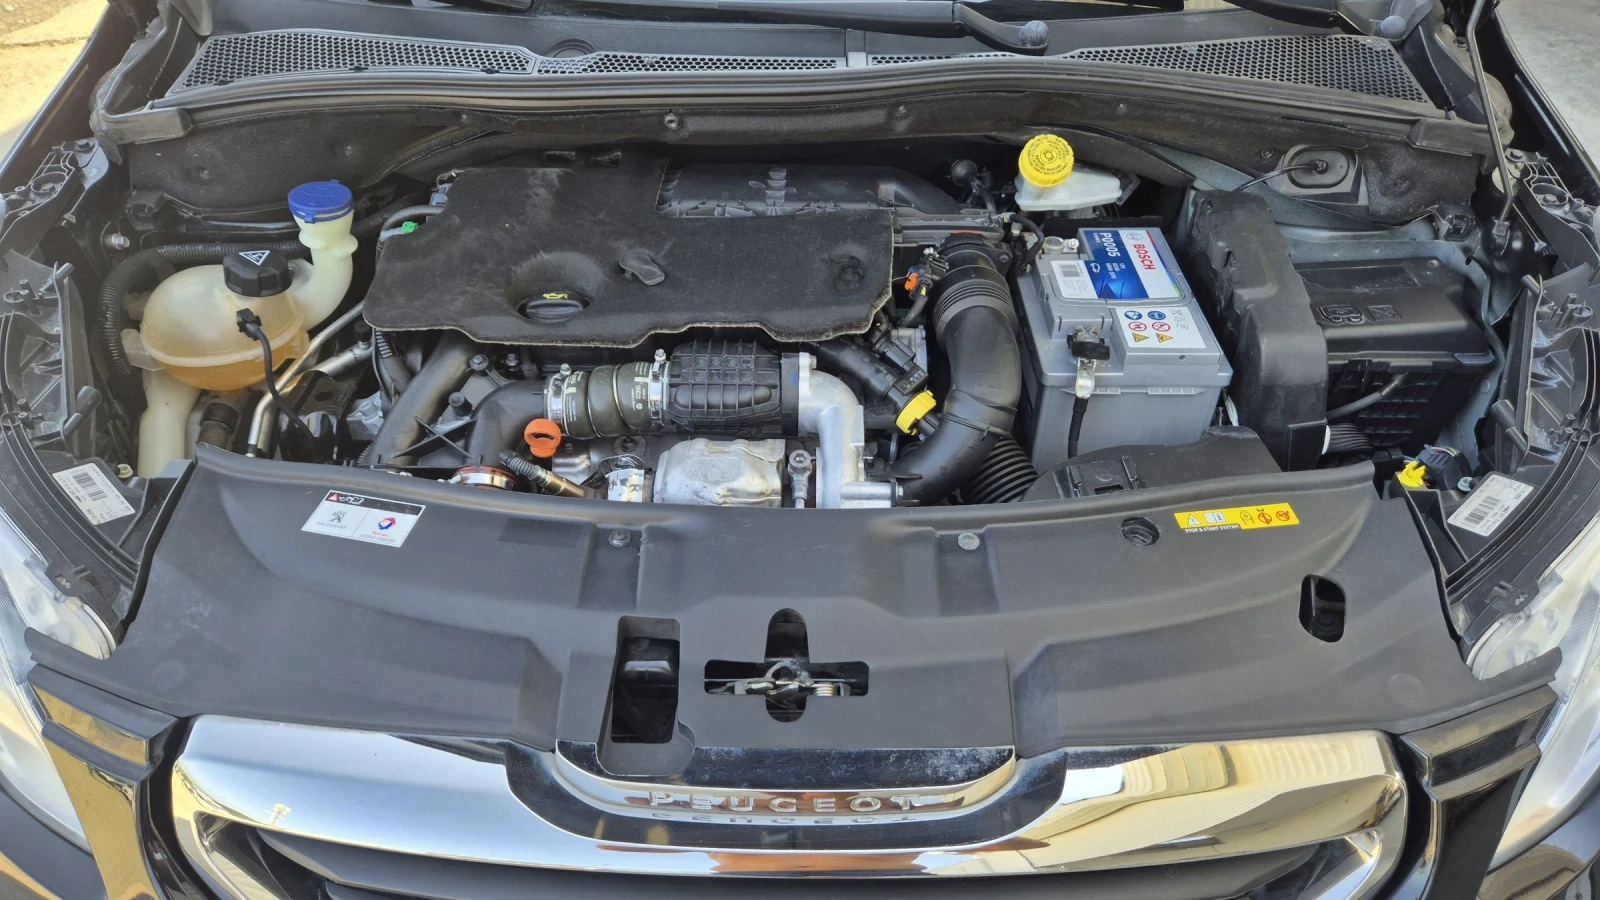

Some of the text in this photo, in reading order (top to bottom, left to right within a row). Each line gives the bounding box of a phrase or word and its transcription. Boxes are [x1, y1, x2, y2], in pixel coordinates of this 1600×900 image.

[1099, 232, 1121, 257] P0005
[1133, 244, 1156, 270] BOSCH
[371, 530, 389, 538] TOTAL
[648, 790, 920, 813] PEUGEOT
